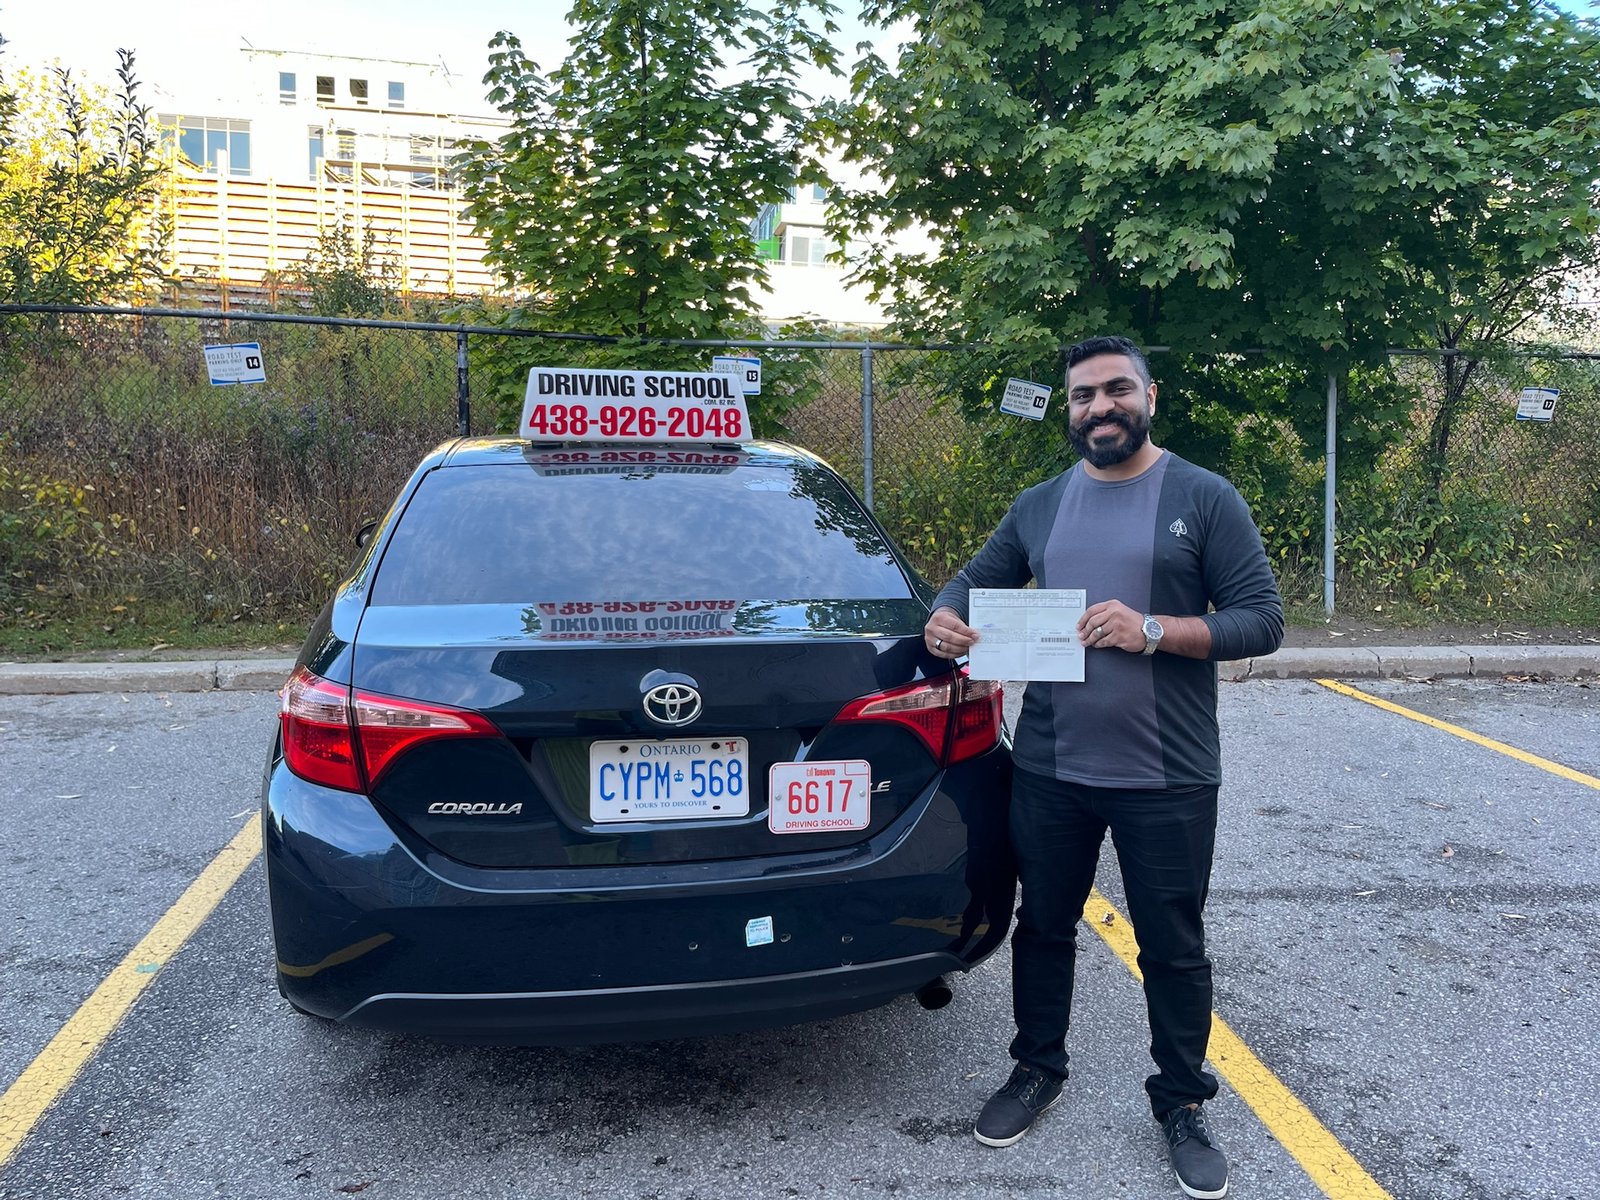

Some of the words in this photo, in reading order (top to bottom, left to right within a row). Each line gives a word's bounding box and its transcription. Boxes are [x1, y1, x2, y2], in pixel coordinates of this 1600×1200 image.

[248, 358, 259, 367] 14
[748, 372, 757, 380] 15
[538, 373, 635, 397] DRIVING
[644, 375, 735, 399] SCHOOL
[1008, 384, 1022, 393] ROAD
[1023, 388, 1035, 396] TEST
[1006, 391, 1022, 399] PARKING
[1035, 397, 1044, 407] 16
[529, 404, 742, 438] 438-926-2048
[640, 744, 701, 757] ONTARIO
[600, 761, 670, 801] CYPM
[691, 759, 742, 798] 568
[788, 780, 853, 815] 6617
[427, 802, 523, 815] COROLLA
[672, 800, 708, 808] DISCOVER
[785, 820, 819, 829] DRIVING
[820, 818, 854, 827] SCHOOL
